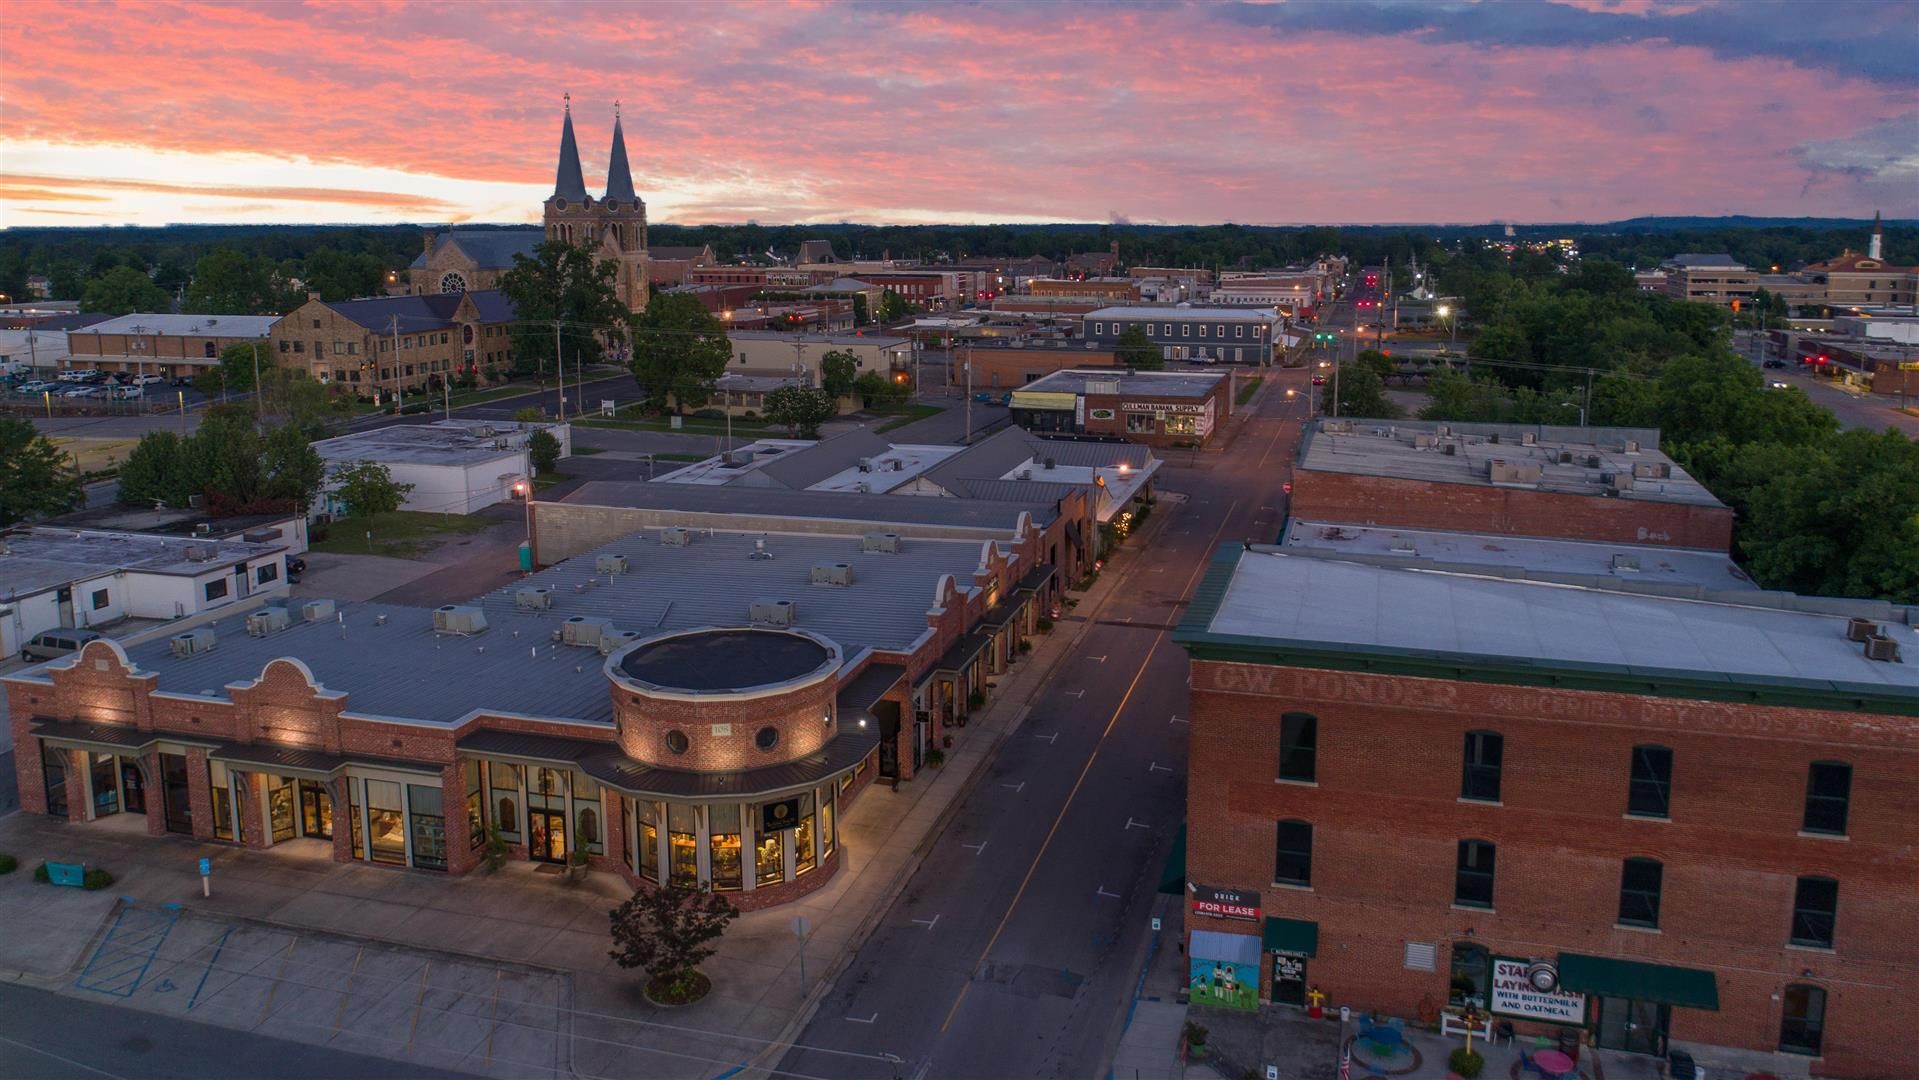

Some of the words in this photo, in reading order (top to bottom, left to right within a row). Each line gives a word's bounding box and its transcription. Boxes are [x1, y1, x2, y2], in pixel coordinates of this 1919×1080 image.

[1175, 404, 1199, 413] SUPPLY
[1199, 902, 1220, 912] FOR
[1222, 904, 1255, 916] LEASE
[1496, 990, 1519, 1000] WITH
[1522, 993, 1578, 1008] BUTTERMILK
[1501, 1001, 1521, 1010] AND
[1524, 1003, 1571, 1017] OATMEAL
